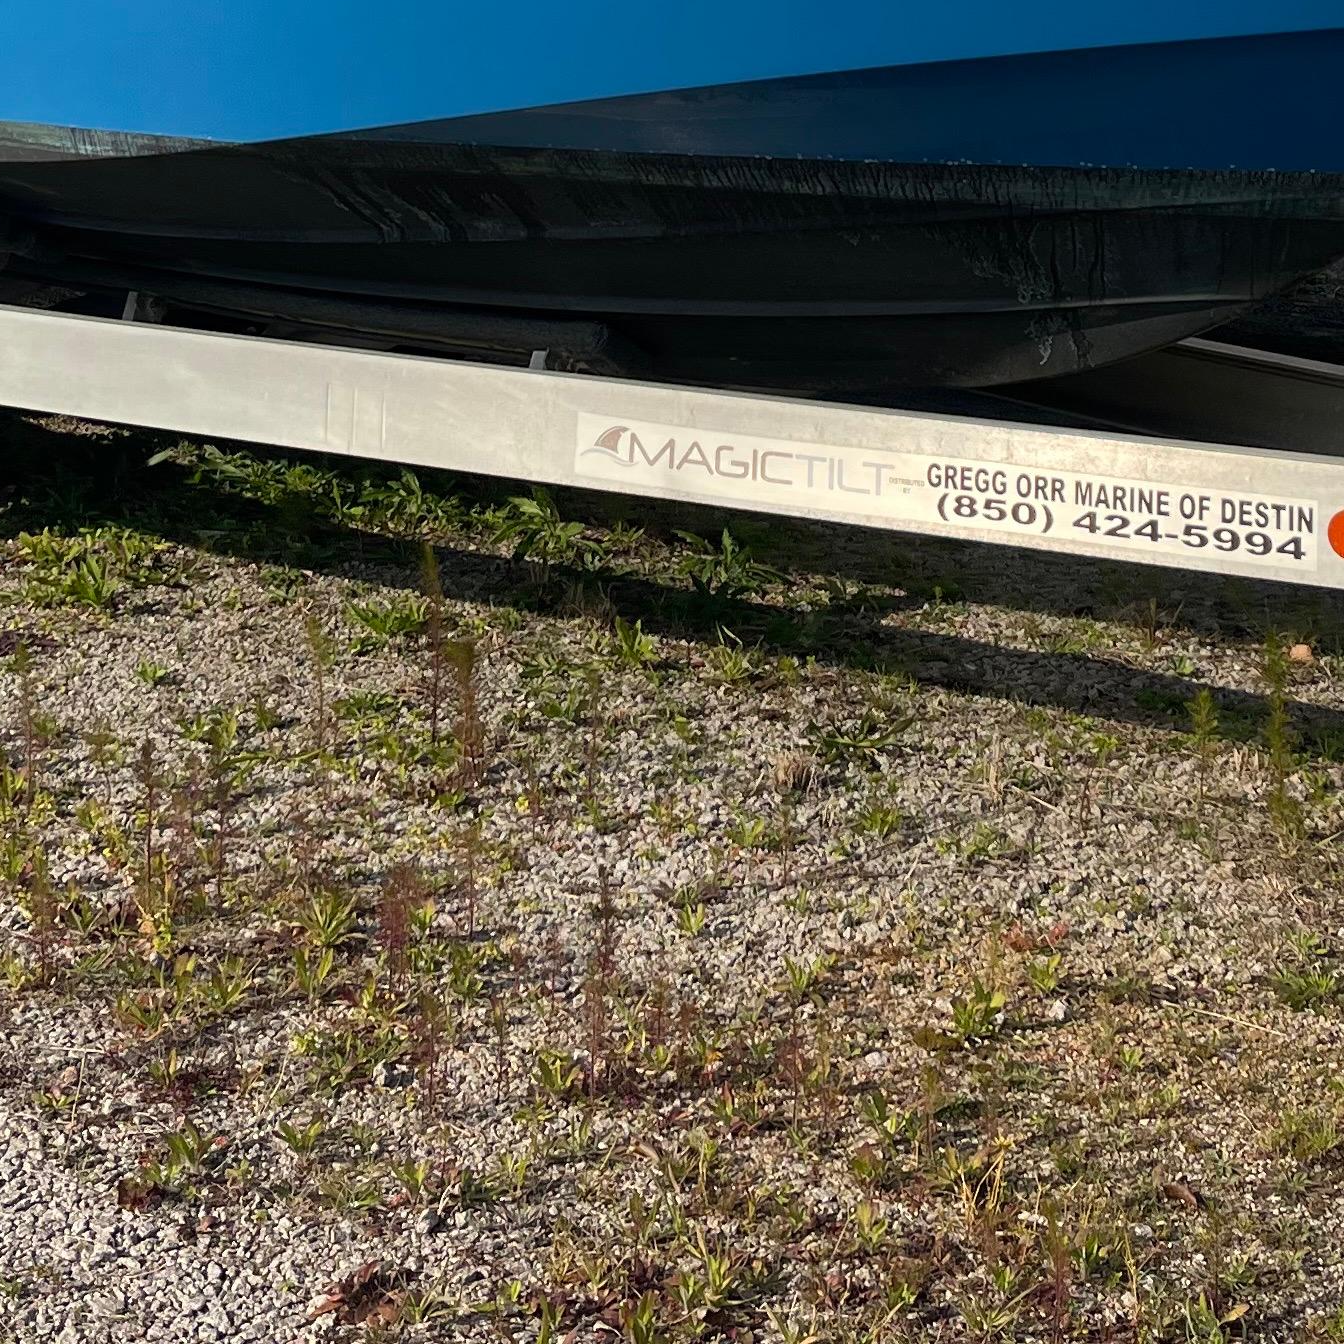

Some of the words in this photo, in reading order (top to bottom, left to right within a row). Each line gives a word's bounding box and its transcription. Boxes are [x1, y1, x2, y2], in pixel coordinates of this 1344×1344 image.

[629, 431, 896, 497] MAGICTILT
[927, 462, 1007, 495] GREGG
[1016, 473, 1065, 503] ORR
[1074, 480, 1170, 518] MARINE
[1179, 492, 1211, 521] OF
[1220, 497, 1315, 534] DESTIN
[936, 492, 1054, 534] (850)
[1072, 511, 1307, 560] 424-5994
